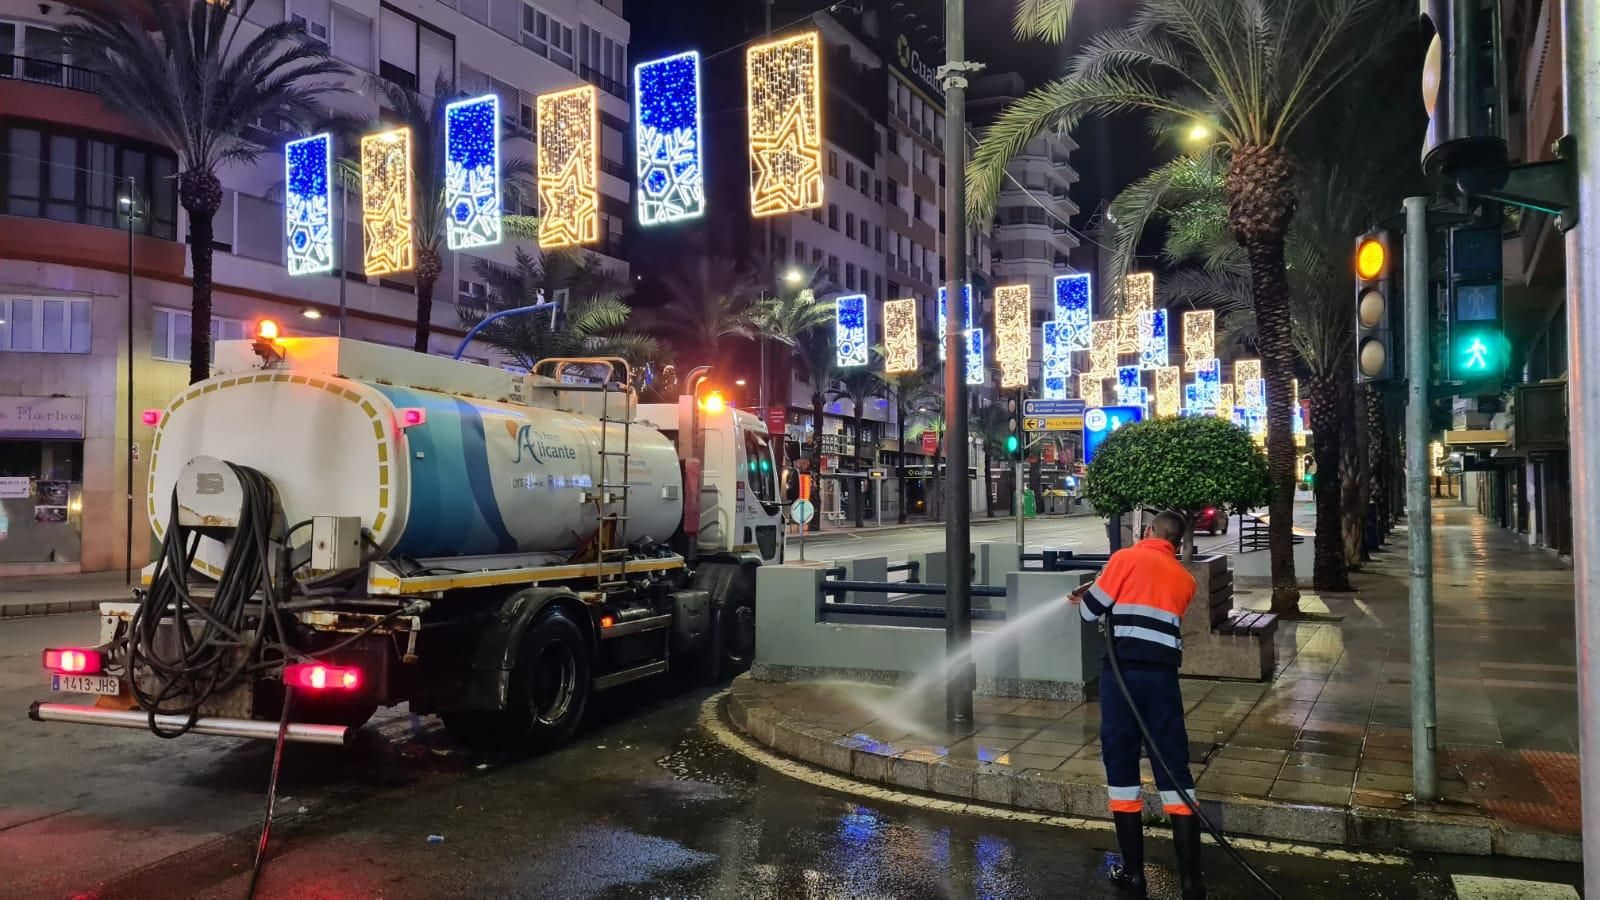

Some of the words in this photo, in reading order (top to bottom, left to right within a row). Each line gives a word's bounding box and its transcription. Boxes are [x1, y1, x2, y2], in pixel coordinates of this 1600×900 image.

[1038, 419, 1045, 428] P
[1091, 415, 1101, 424] P
[512, 425, 576, 465] Alicante
[65, 676, 91, 691] 1413
